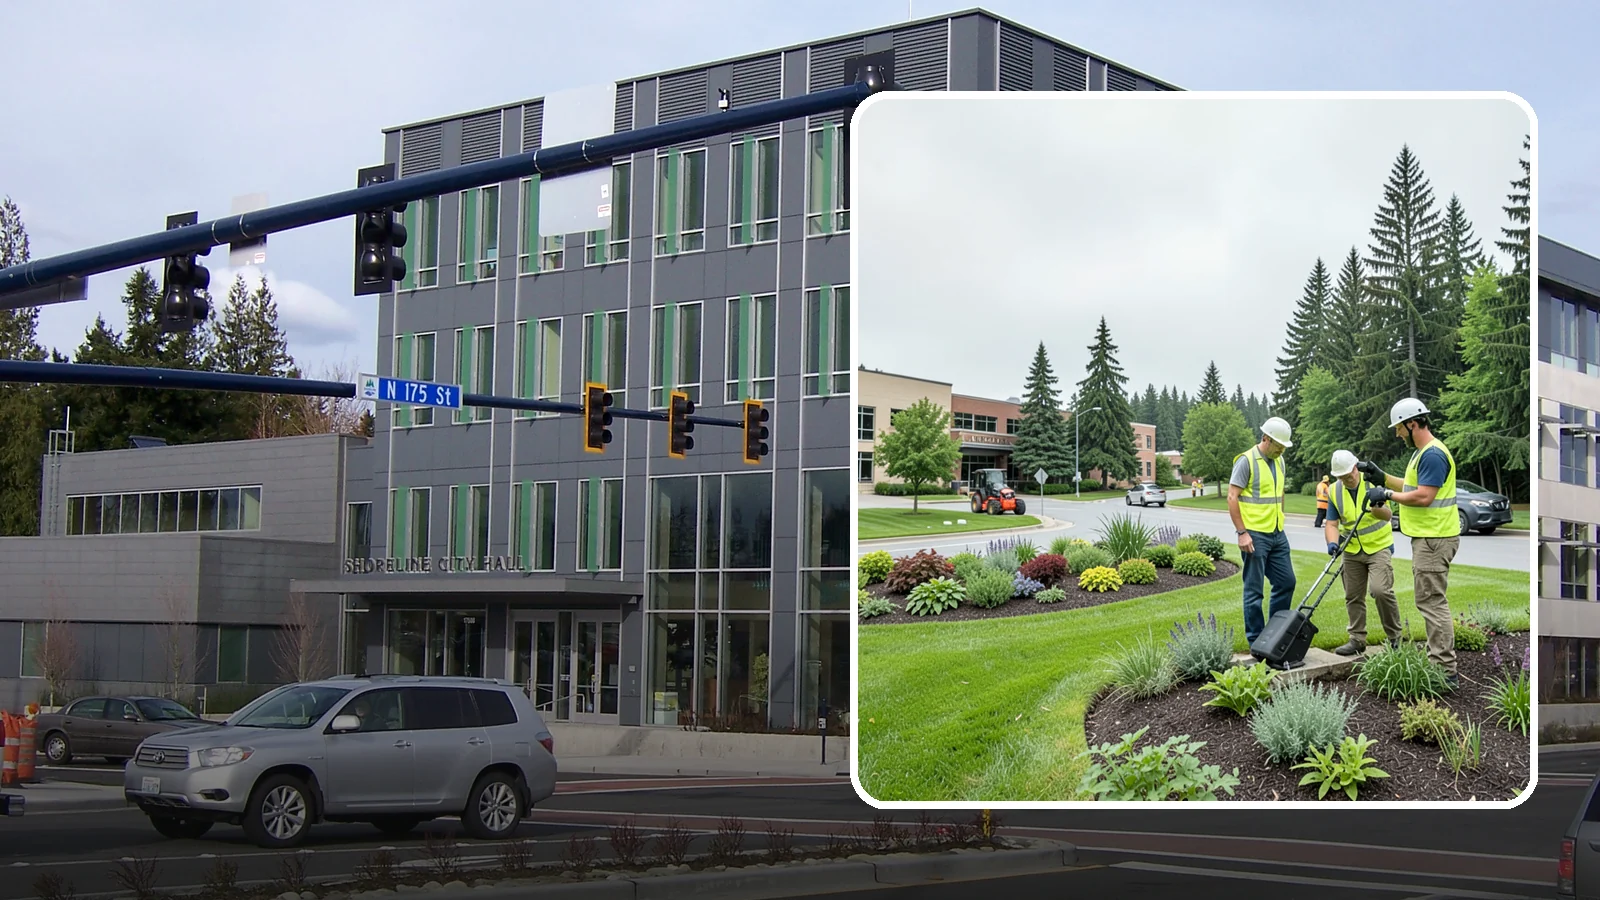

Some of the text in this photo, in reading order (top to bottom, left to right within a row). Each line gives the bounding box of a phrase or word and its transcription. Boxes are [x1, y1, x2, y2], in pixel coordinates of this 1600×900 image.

[387, 380, 451, 406] N 175 St
[344, 555, 526, 574] SHORELINE CITY HALL
